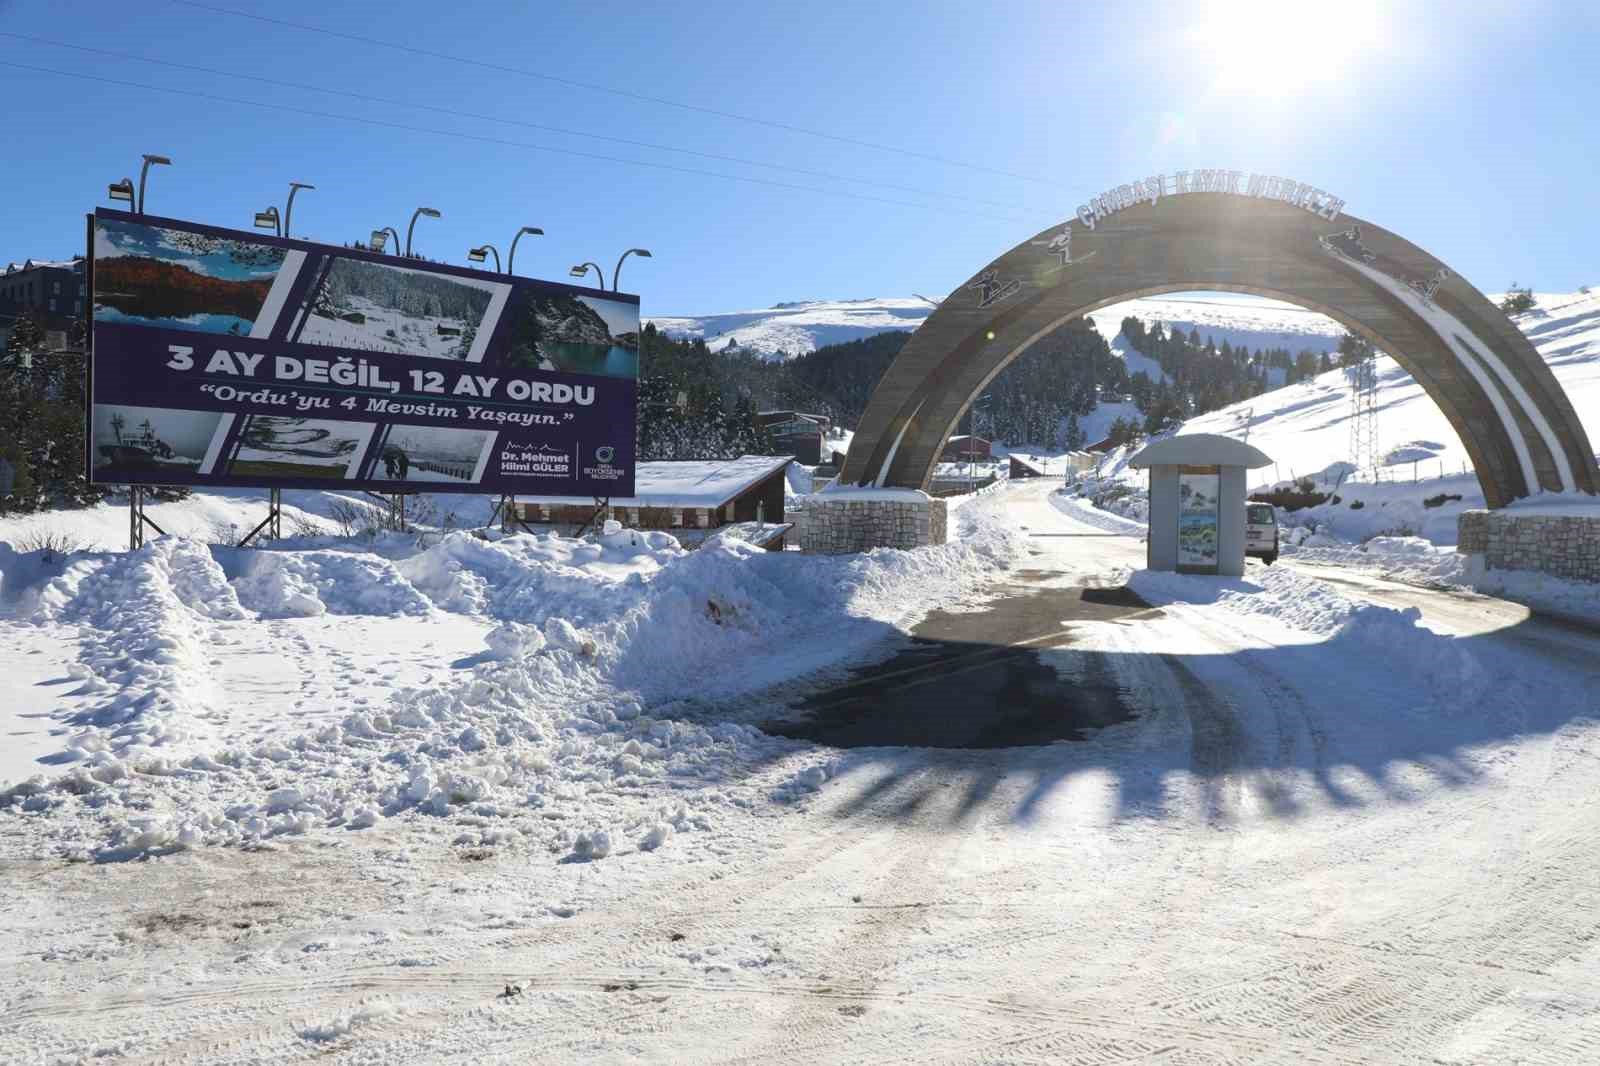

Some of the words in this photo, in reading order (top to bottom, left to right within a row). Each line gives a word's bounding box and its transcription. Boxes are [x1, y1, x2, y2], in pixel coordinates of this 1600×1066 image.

[1176, 168, 1242, 194] KAYAK
[167, 344, 194, 371] 3
[205, 350, 265, 377] AY
[275, 356, 400, 393] DEĞİL,
[409, 369, 445, 393] 12
[452, 374, 499, 398] AY
[507, 379, 595, 405] ORDU
[340, 397, 358, 411] 4
[365, 398, 458, 418] Mevsim
[501, 451, 518, 461] Dr.
[521, 453, 569, 463] Mehmet
[501, 462, 530, 471] Hilmi
[532, 462, 569, 473] GÜLER
